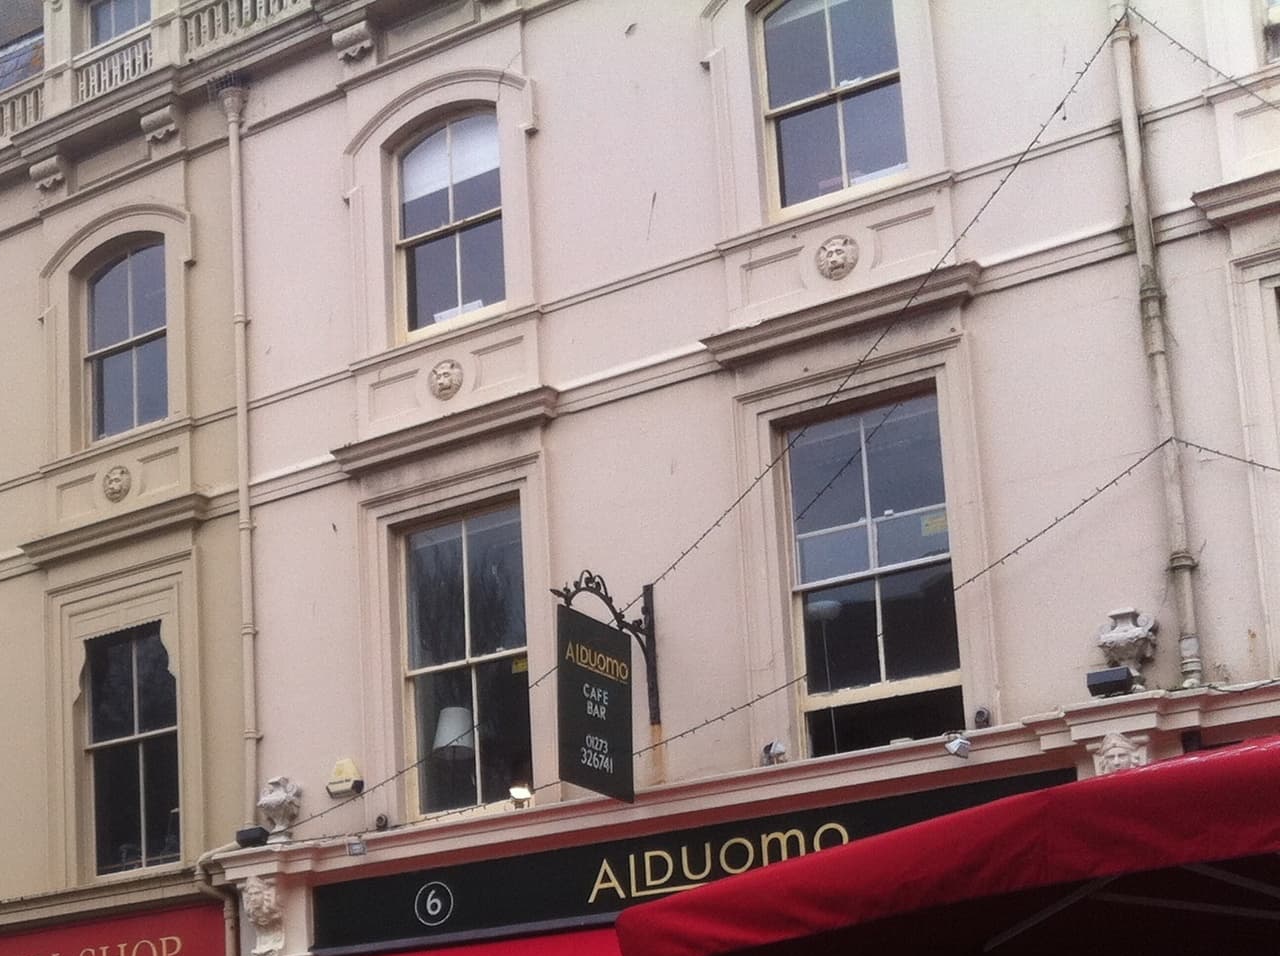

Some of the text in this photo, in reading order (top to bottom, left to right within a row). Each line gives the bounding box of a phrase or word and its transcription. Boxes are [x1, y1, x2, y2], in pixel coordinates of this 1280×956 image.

[583, 683, 609, 705] CAFE
[586, 700, 607, 720] BAR
[585, 734, 608, 754] 01273
[581, 747, 613, 774] 326741
[425, 889, 443, 916] 6
